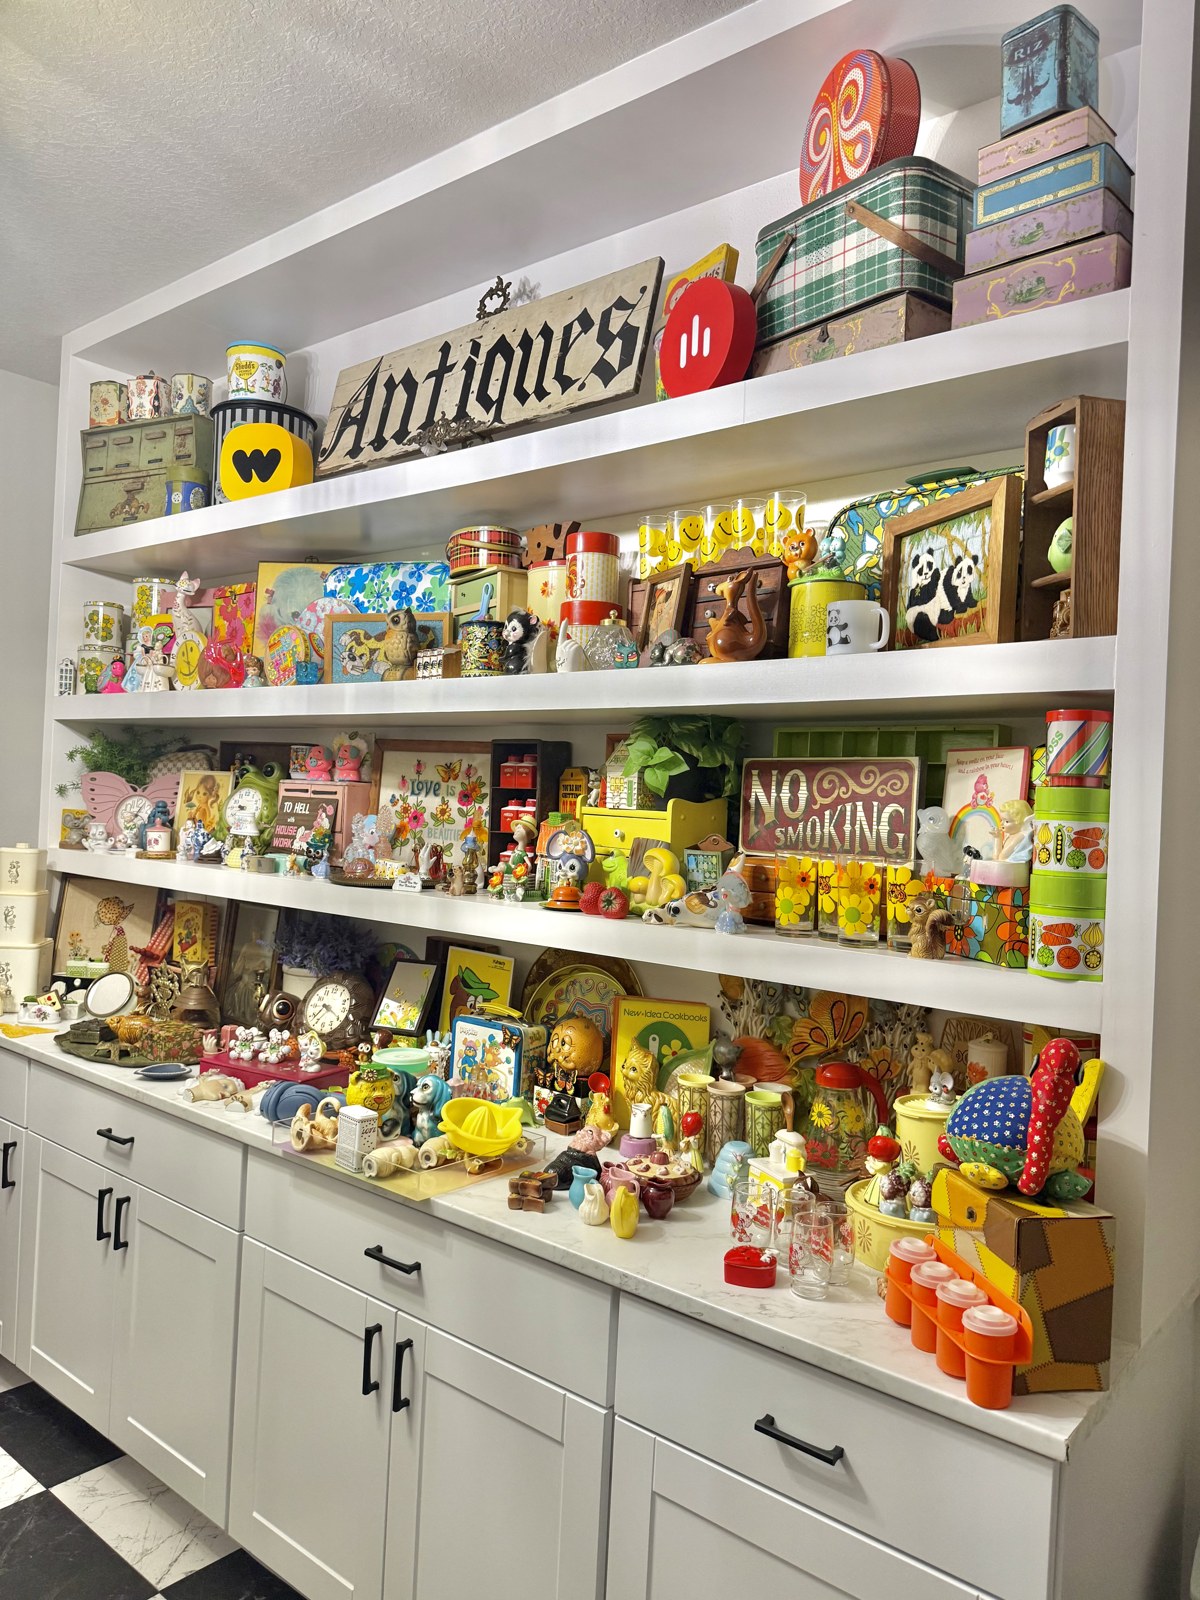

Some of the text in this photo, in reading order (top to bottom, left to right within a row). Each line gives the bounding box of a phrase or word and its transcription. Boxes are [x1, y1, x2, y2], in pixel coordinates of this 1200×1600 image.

[1014, 40, 1043, 61] RIZ
[319, 285, 648, 461] Antiques
[283, 801, 310, 814] TO HELL
[748, 768, 809, 845] NO
[275, 825, 297, 836] HOUSE
[427, 827, 461, 841] BEAUTIF
[774, 801, 906, 855] SMOKING
[272, 837, 294, 848] WORK
[662, 1011, 708, 1022] Cookbooks
[361, 1127, 377, 1135] LOVE
